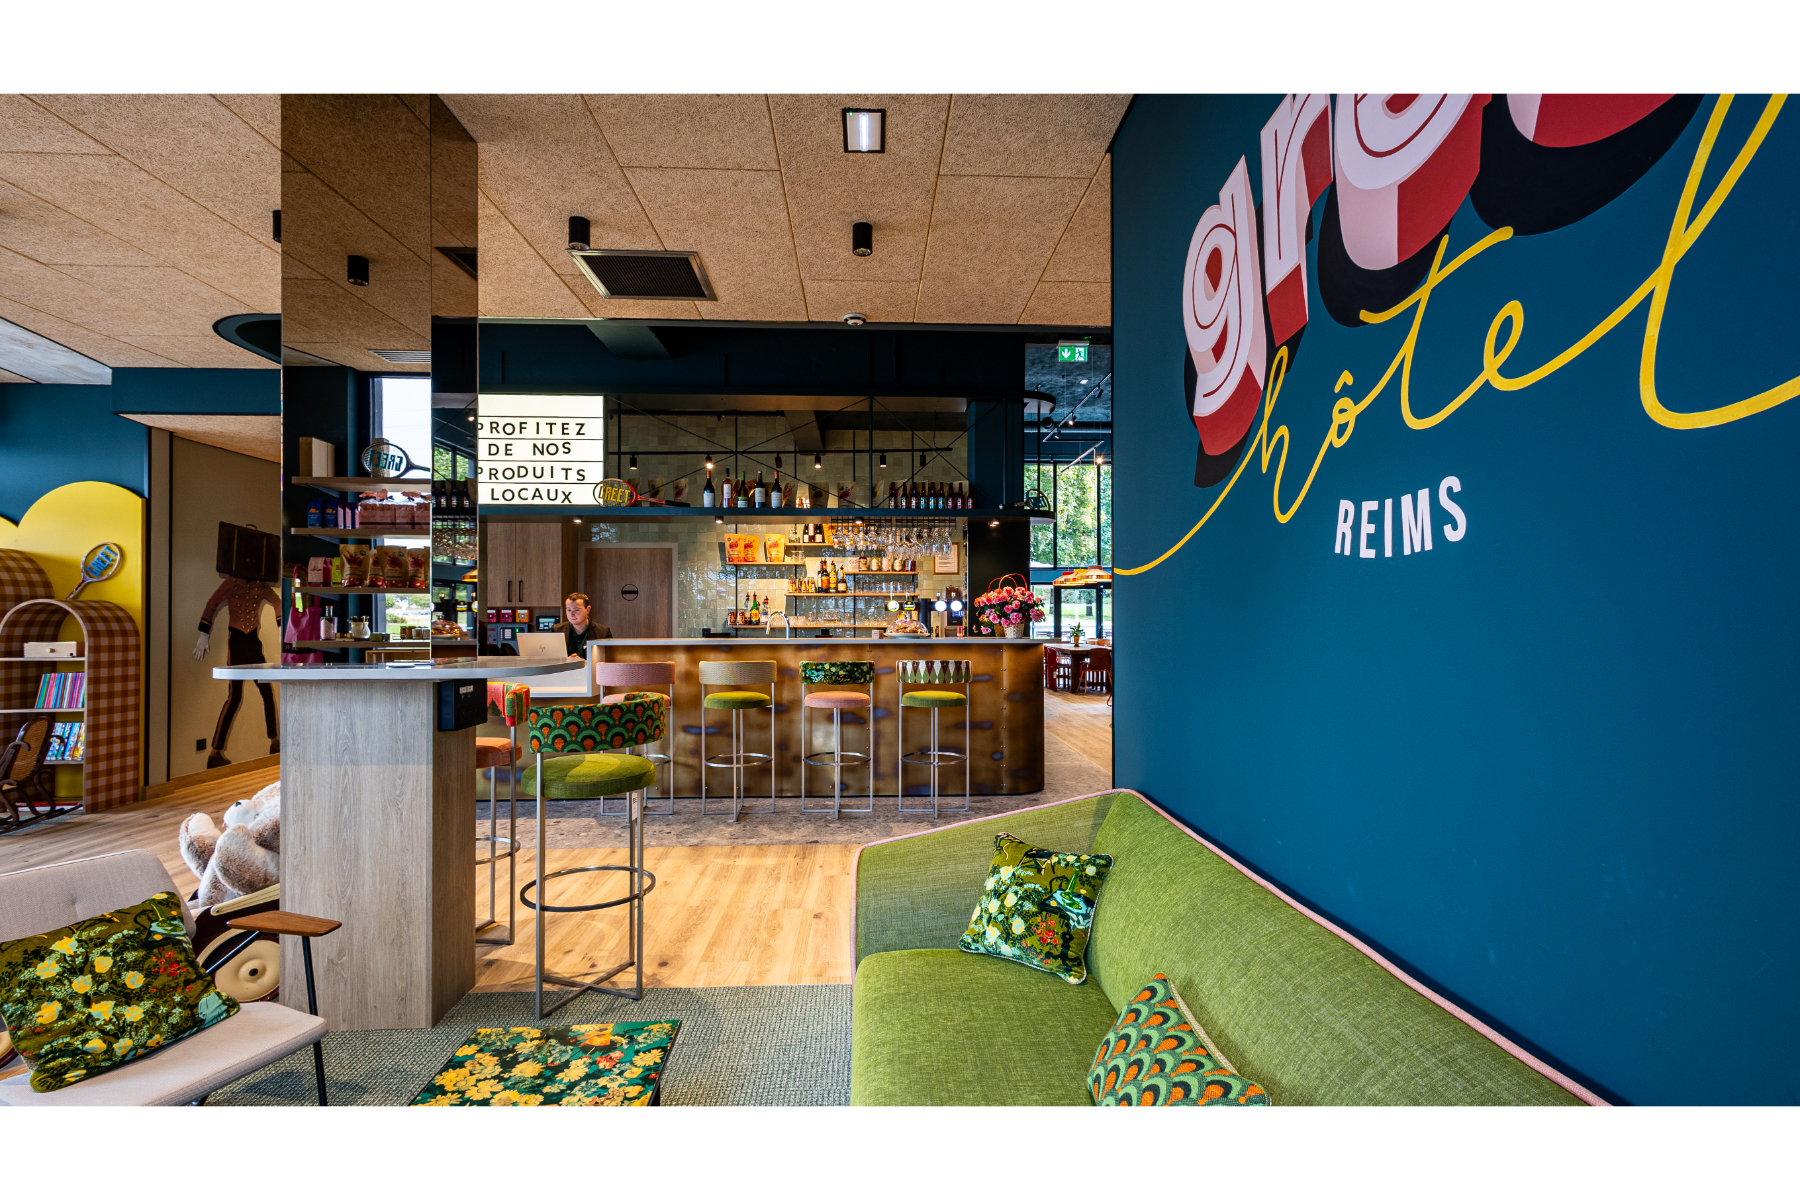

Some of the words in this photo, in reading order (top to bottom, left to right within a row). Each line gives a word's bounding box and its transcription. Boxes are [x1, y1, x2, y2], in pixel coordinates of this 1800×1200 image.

[1114, 93, 1800, 575] hôtel
[488, 443, 513, 456] DE
[533, 441, 572, 456] NOS
[491, 487, 573, 504] LOCAUX
[598, 485, 631, 504] GREET
[1334, 475, 1467, 559] REIMS
[86, 545, 117, 577] GREET
